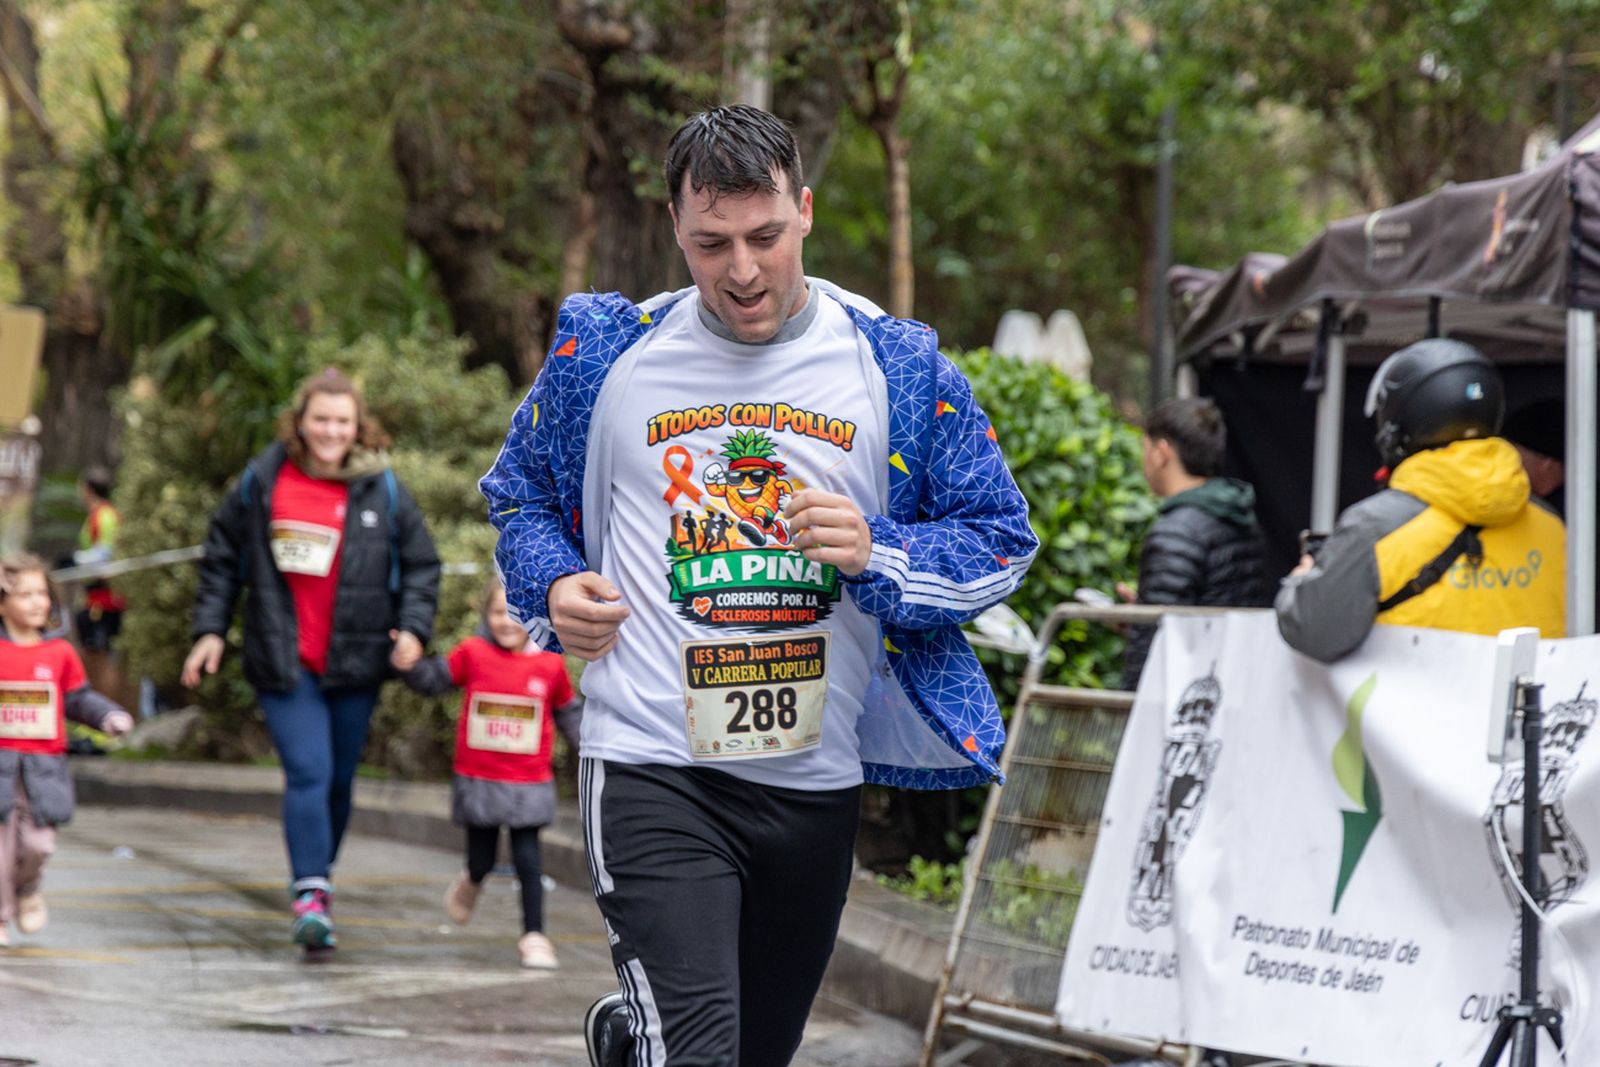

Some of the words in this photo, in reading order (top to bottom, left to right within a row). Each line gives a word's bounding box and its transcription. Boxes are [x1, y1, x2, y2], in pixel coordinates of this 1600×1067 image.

[646, 403, 727, 446] ¡TODOS
[728, 402, 772, 428] CON
[773, 402, 857, 452] POLLO!
[691, 558, 733, 587] LA
[741, 551, 824, 586] PIÑA
[711, 609, 770, 622] ESCLEROSIS
[772, 607, 816, 621] MÚLTIPLE
[716, 592, 778, 607] CORREMOS
[781, 594, 803, 606] POR
[806, 595, 818, 606] LA
[694, 648, 714, 664] IES
[718, 647, 745, 663] San
[748, 645, 781, 661] Juan
[785, 641, 818, 657] Bosco
[692, 668, 700, 685] V
[704, 664, 767, 684] CARRERA
[770, 659, 821, 680] POPULAR
[725, 686, 797, 734] 288
[1231, 915, 1311, 949] Patronato
[1314, 928, 1396, 962] Municipal
[1396, 940, 1420, 964] de
[1244, 951, 1317, 985] Deportes
[1319, 963, 1342, 988] de
[1344, 967, 1384, 993] Jaén
